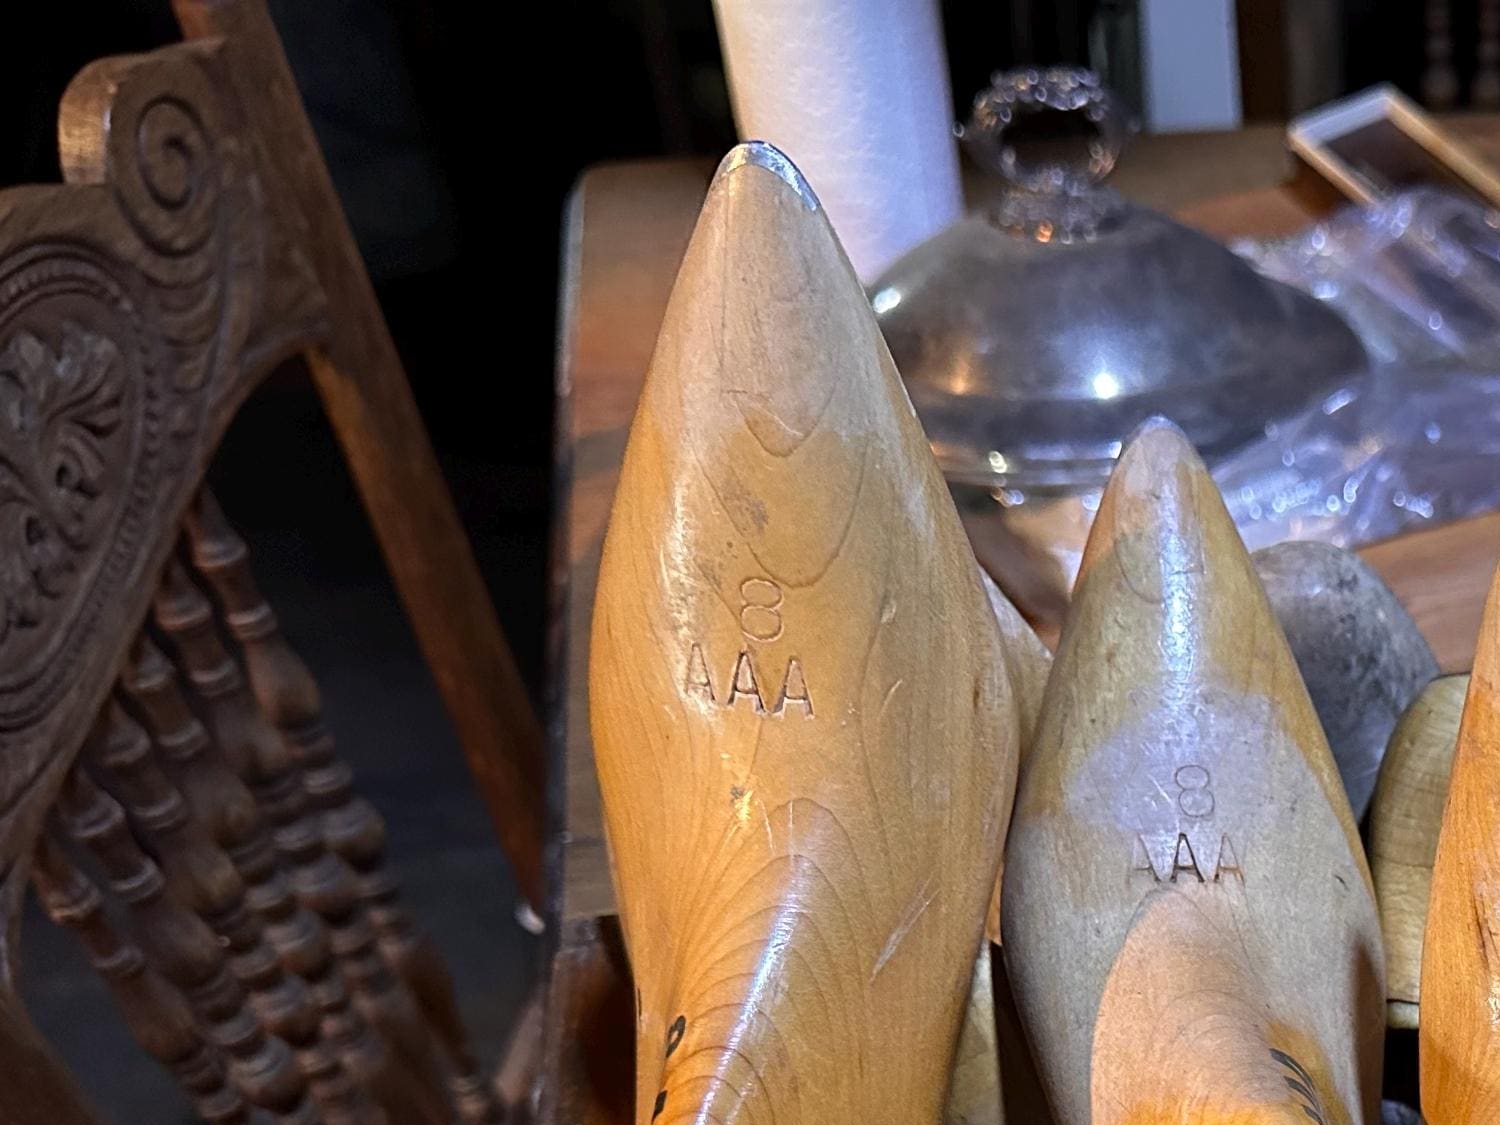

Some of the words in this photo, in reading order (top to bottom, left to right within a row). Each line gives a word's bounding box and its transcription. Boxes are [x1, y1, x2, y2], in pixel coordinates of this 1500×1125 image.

[740, 577, 784, 643] 8
[685, 642, 815, 720] AAA
[1174, 764, 1216, 818] 8
